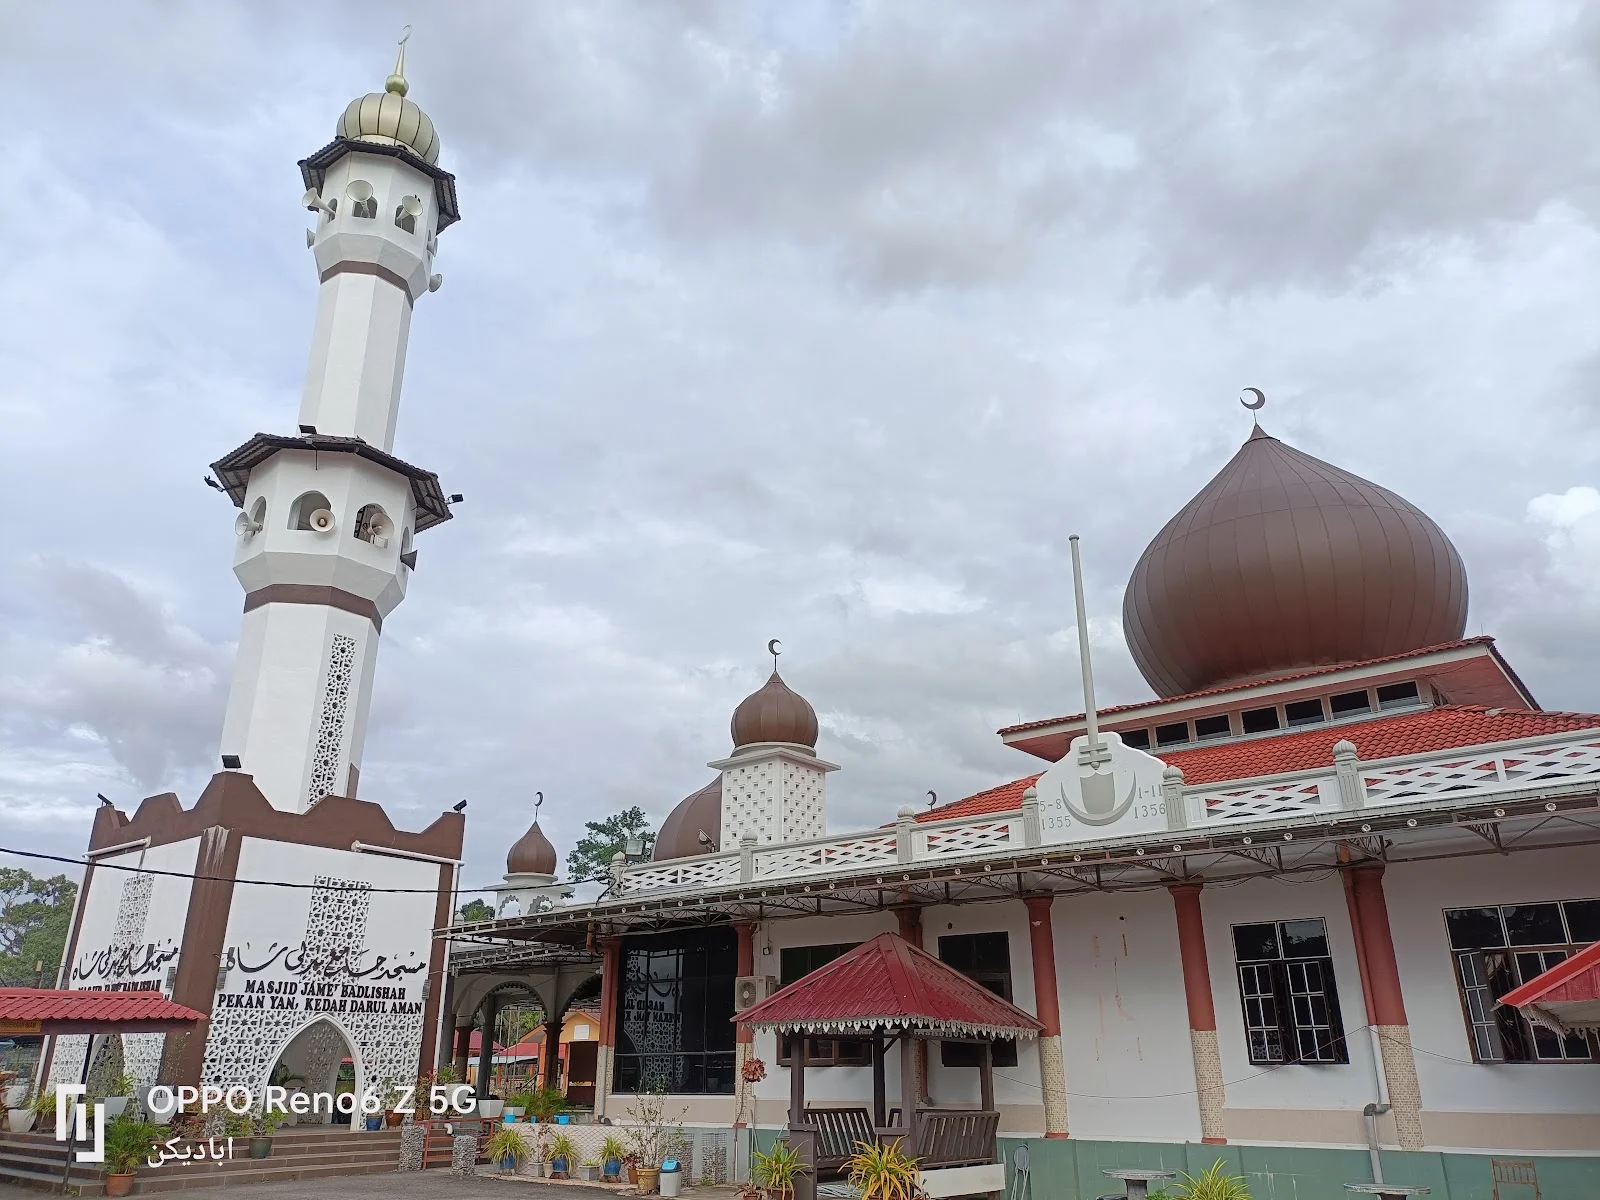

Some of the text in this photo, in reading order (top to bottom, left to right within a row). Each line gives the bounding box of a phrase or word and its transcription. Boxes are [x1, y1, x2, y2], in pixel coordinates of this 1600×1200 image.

[1039, 798, 1062, 812] 5-8
[1134, 803, 1167, 819] 1356
[1041, 815, 1072, 831] 1355
[244, 979, 298, 995] MASJID
[341, 984, 406, 1001] BADLISHAH
[217, 993, 423, 1015] PEKAN YAN, KEDAH DARUL AMAN
